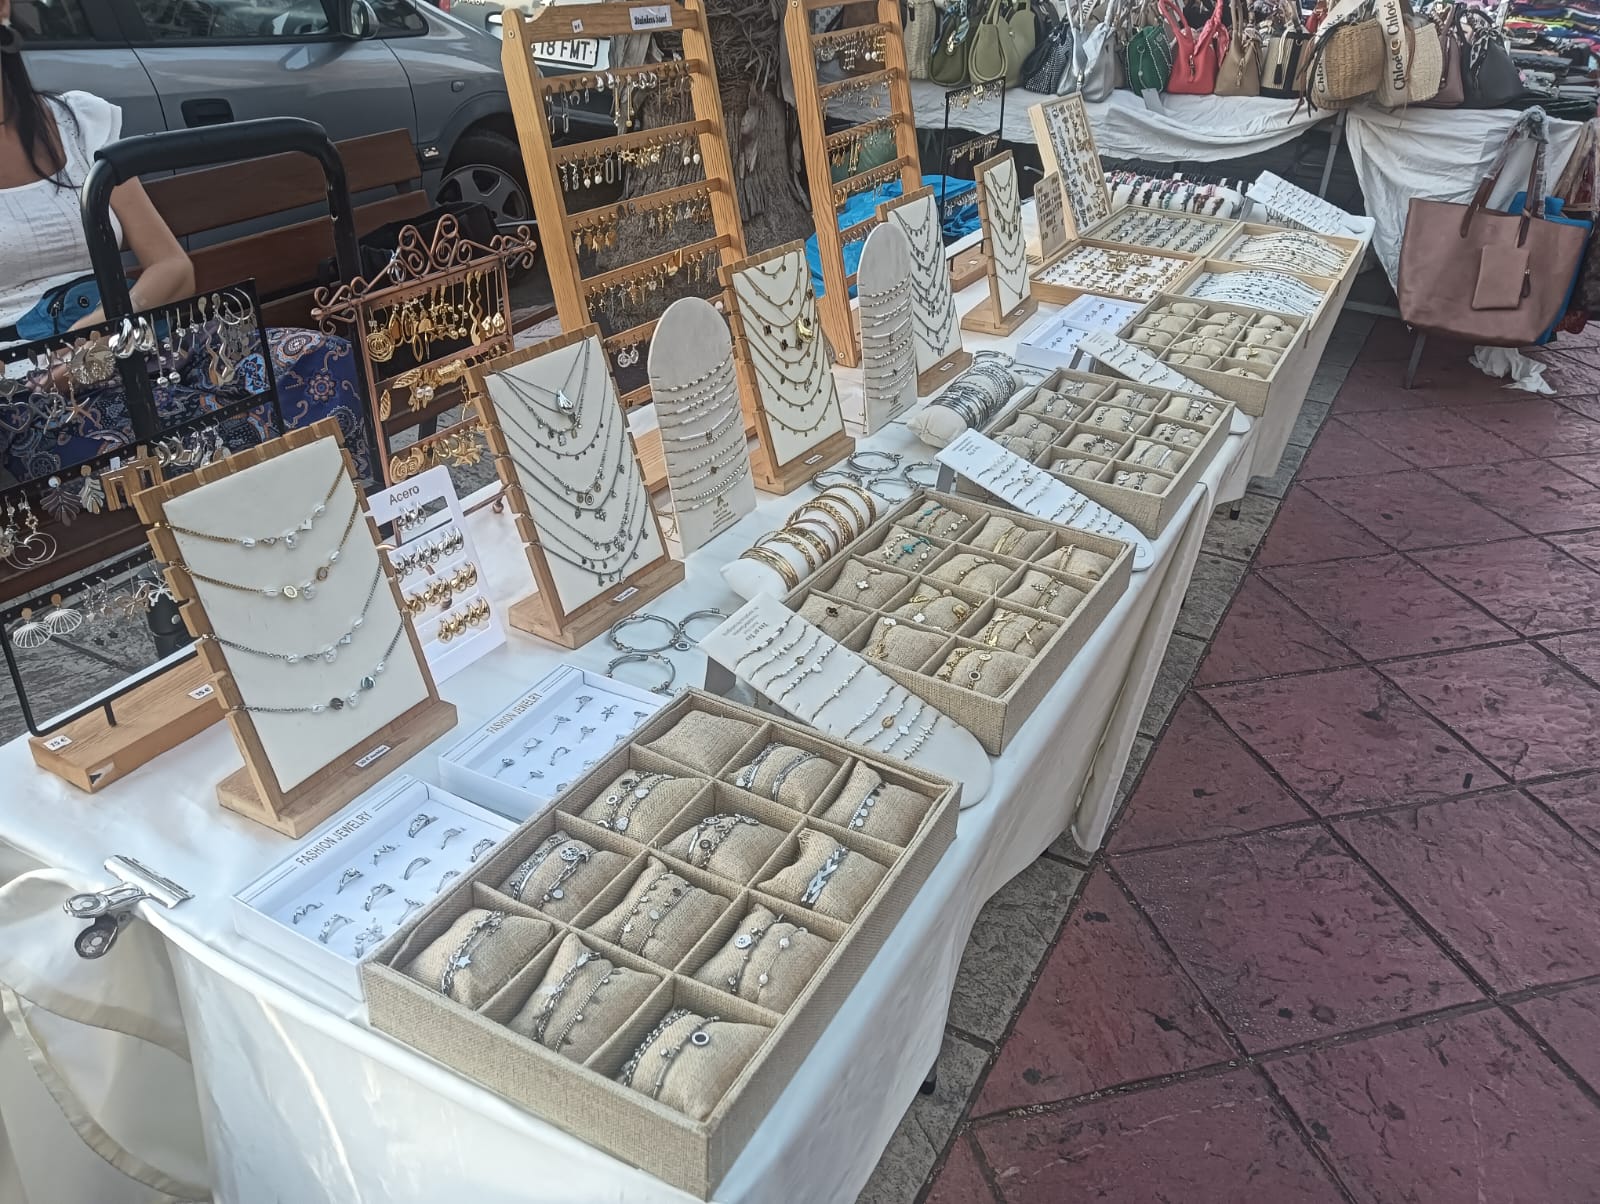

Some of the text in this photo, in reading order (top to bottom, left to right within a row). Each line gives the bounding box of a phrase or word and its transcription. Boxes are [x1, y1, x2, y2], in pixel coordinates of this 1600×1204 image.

[1384, 1, 1400, 36] Chloé
[560, 39, 591, 61] FMT
[1393, 54, 1406, 91] Chloé
[389, 485, 420, 506] Acero
[486, 692, 543, 734] FASHION JEWELRY
[295, 810, 373, 866] FASHION JEWELRY
